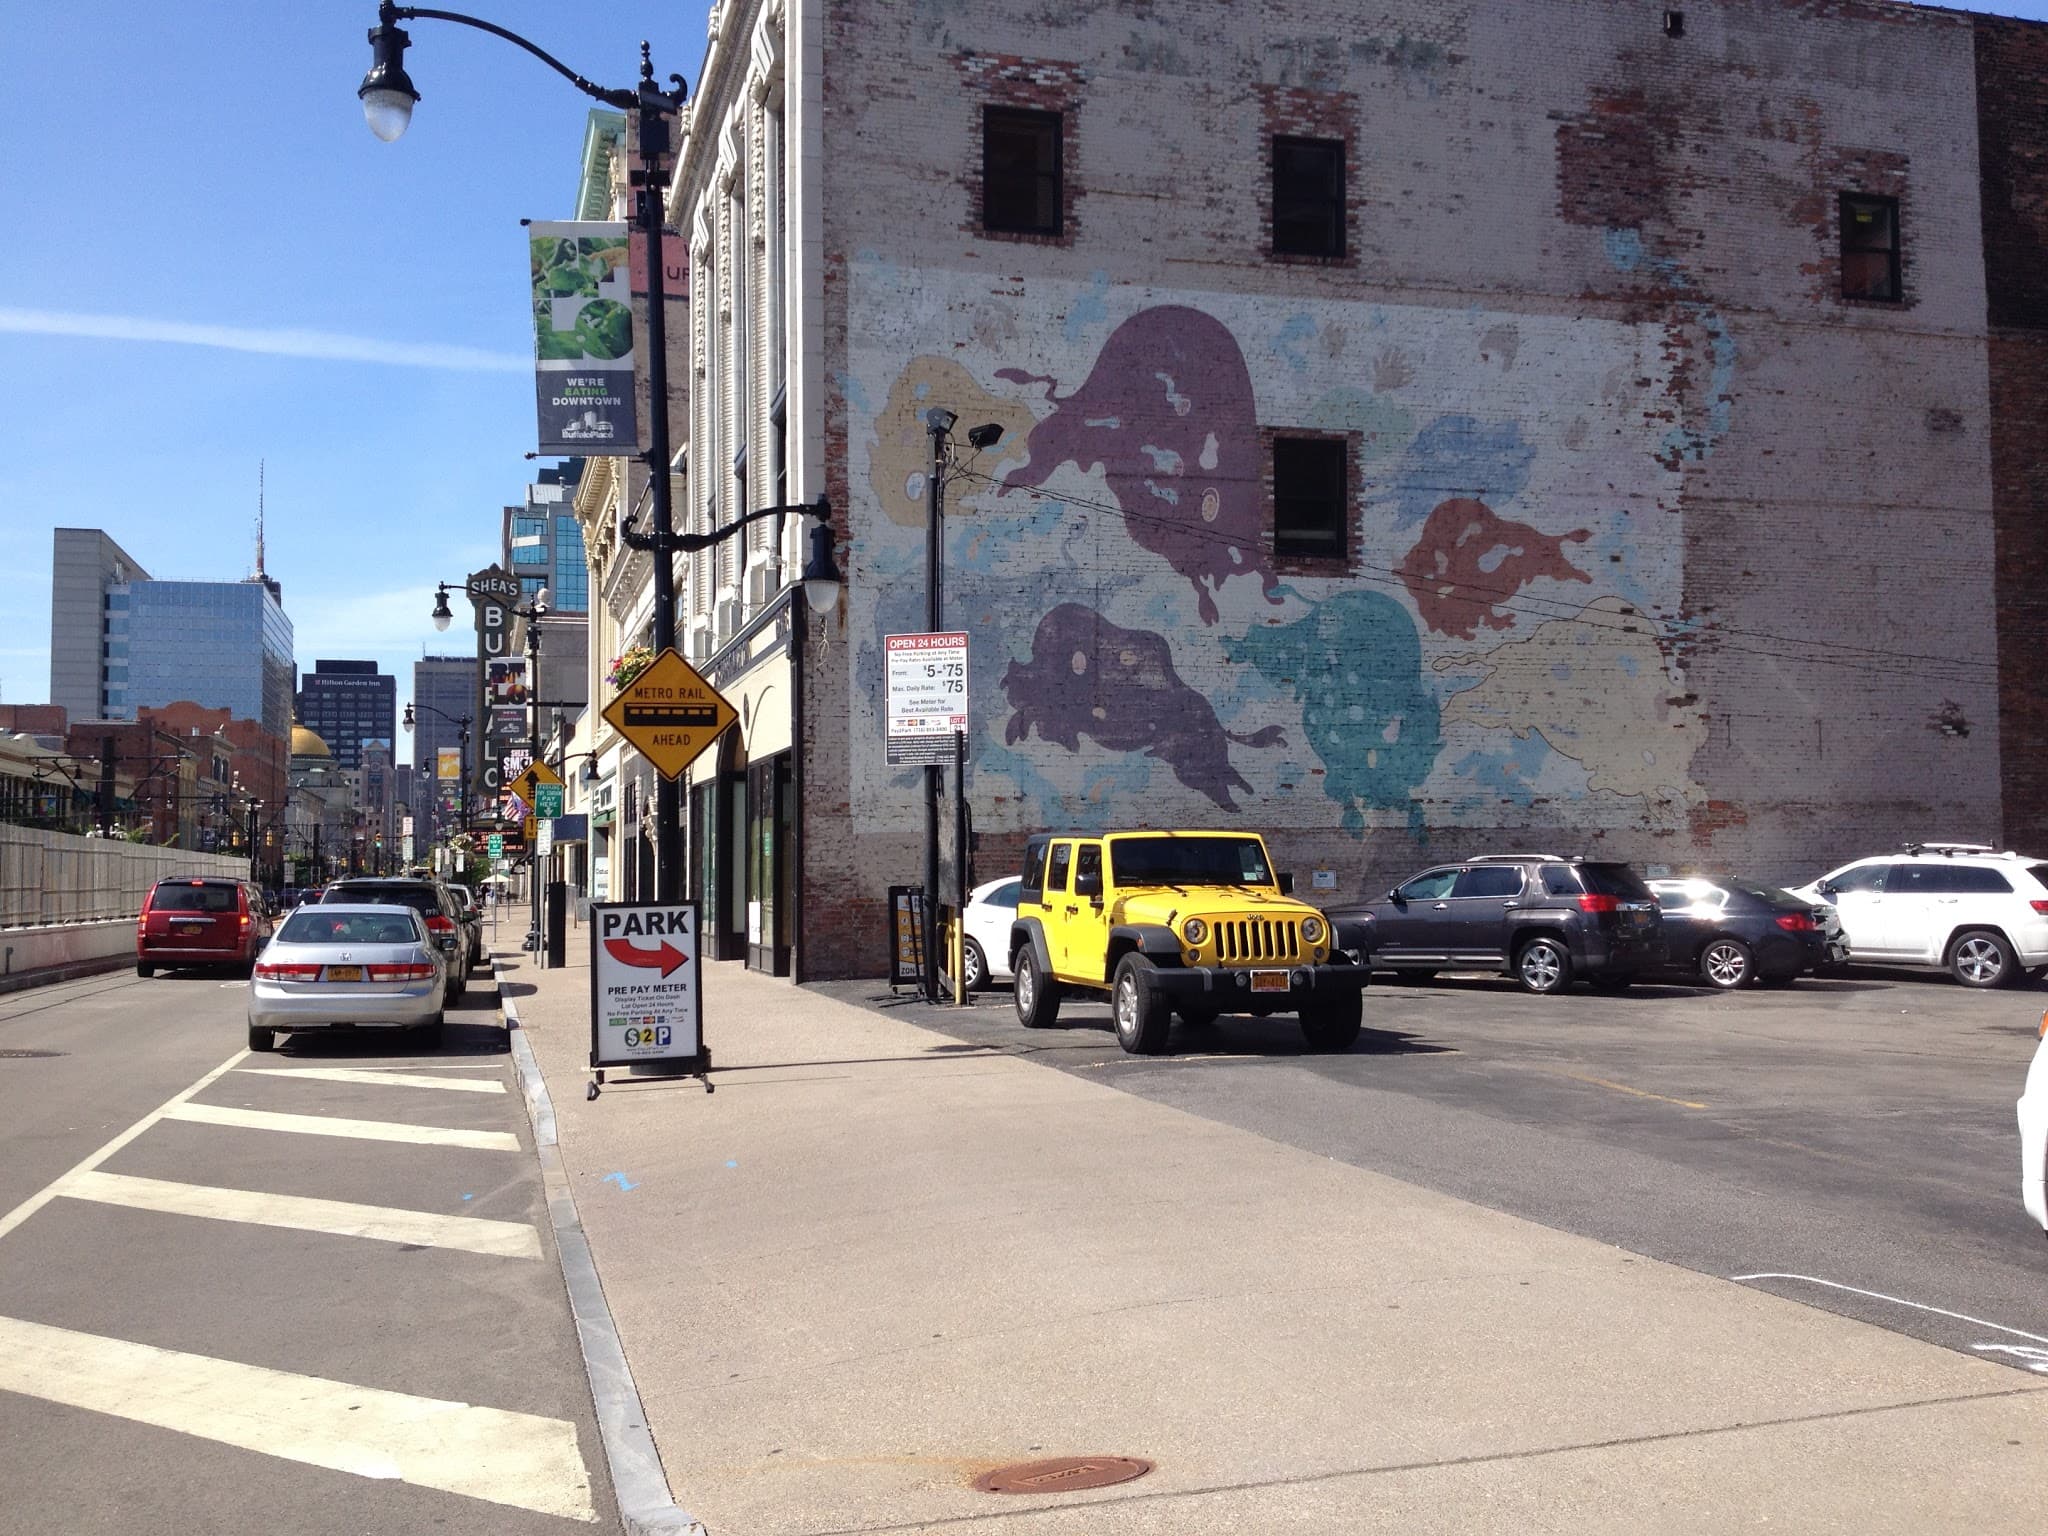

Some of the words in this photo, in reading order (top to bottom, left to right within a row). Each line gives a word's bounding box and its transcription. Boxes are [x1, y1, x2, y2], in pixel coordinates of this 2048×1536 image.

[566, 378, 605, 386] WE'RE
[564, 388, 608, 396] EATING
[552, 397, 621, 406] DOWNTOWN
[472, 578, 518, 596] SHEA'S
[890, 640, 916, 648] OPEN
[918, 639, 928, 648] 24
[931, 637, 965, 647] HOURS
[942, 680, 964, 693] $75
[635, 688, 672, 698] METRO
[679, 688, 705, 699] RAIL
[653, 734, 691, 745] AHEAD
[603, 911, 689, 937] PARK
[608, 986, 627, 995] PRE
[630, 985, 650, 994] PAY
[653, 984, 687, 993] METER
